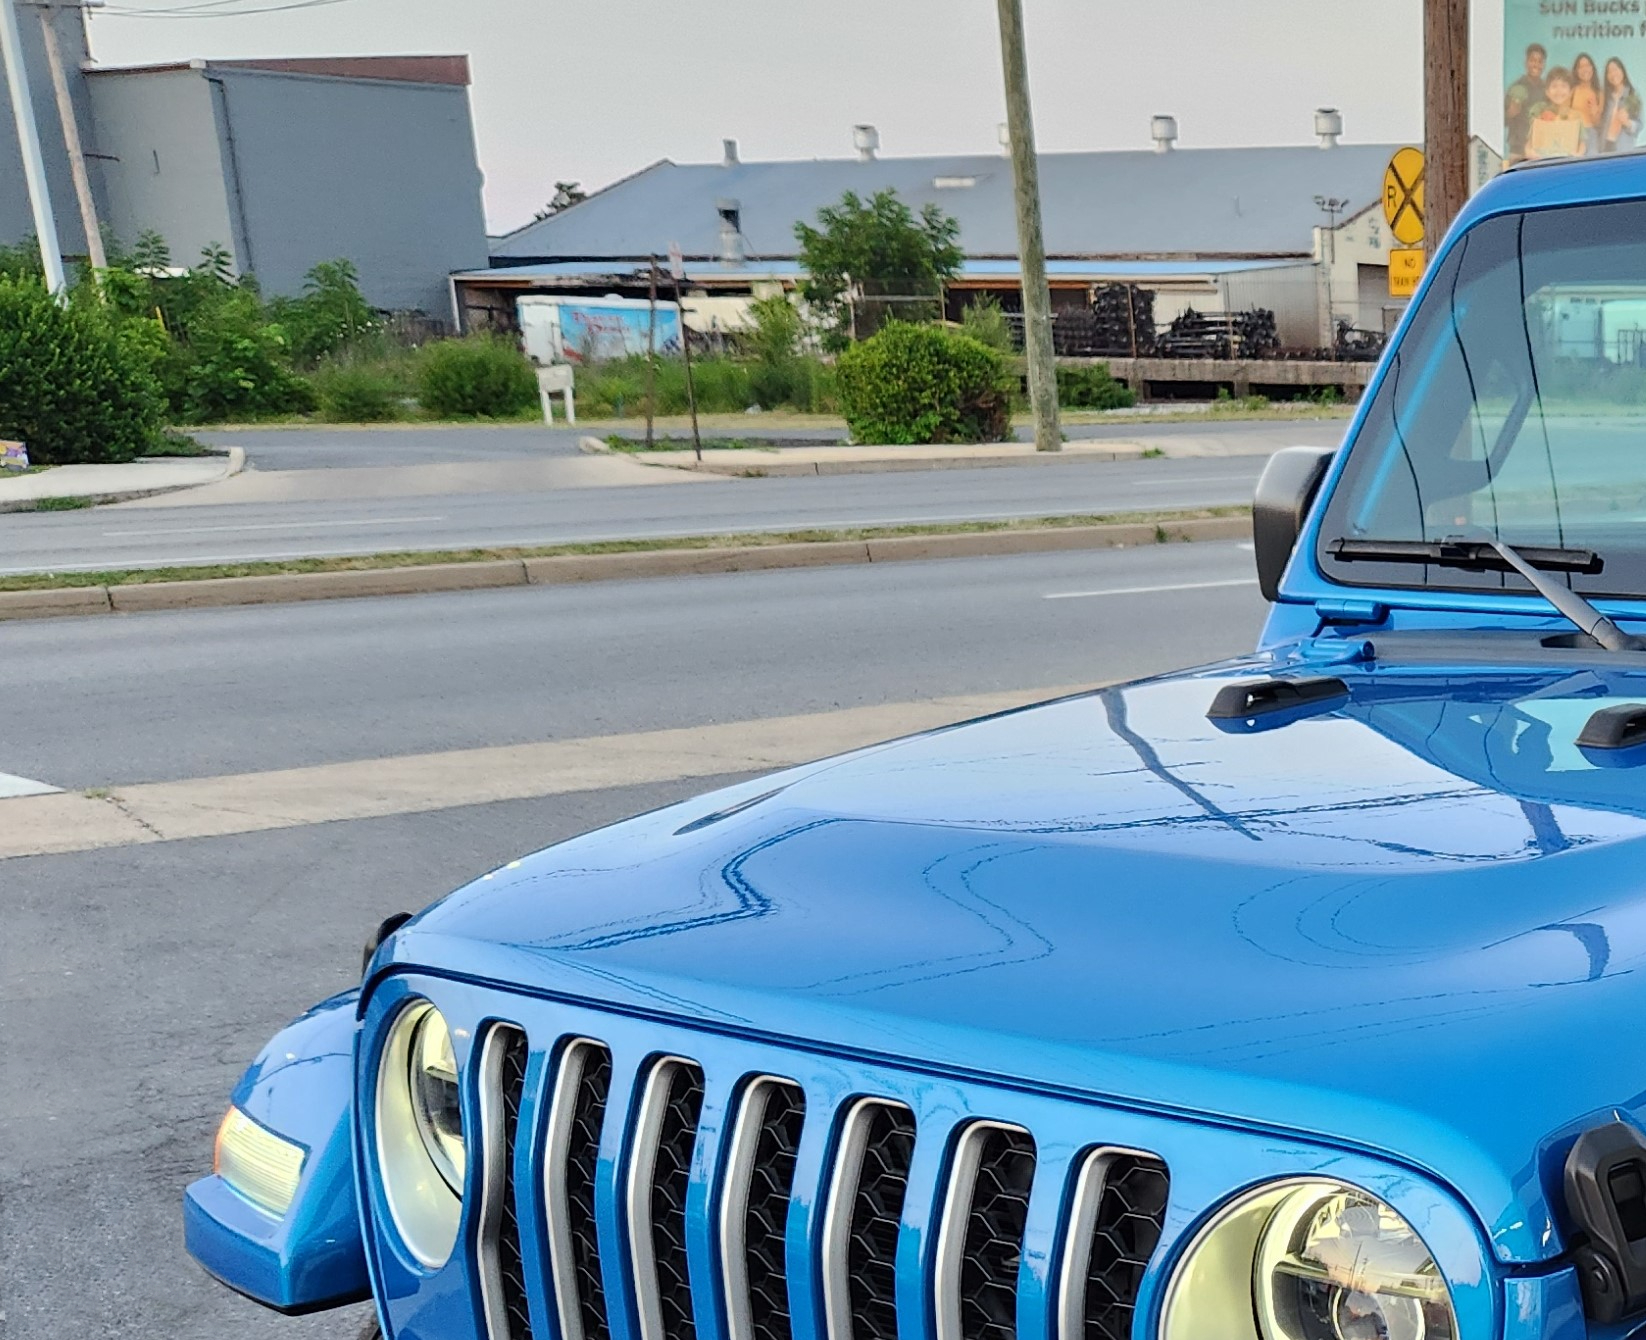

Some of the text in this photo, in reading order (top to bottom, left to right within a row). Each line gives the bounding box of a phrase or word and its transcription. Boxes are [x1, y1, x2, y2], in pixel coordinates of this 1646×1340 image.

[1539, 0, 1577, 15] SUN
[1583, 0, 1640, 14] Bucks
[1551, 20, 1635, 38] nutrition
[1387, 185, 1397, 208] R
[1404, 258, 1416, 269] NO
